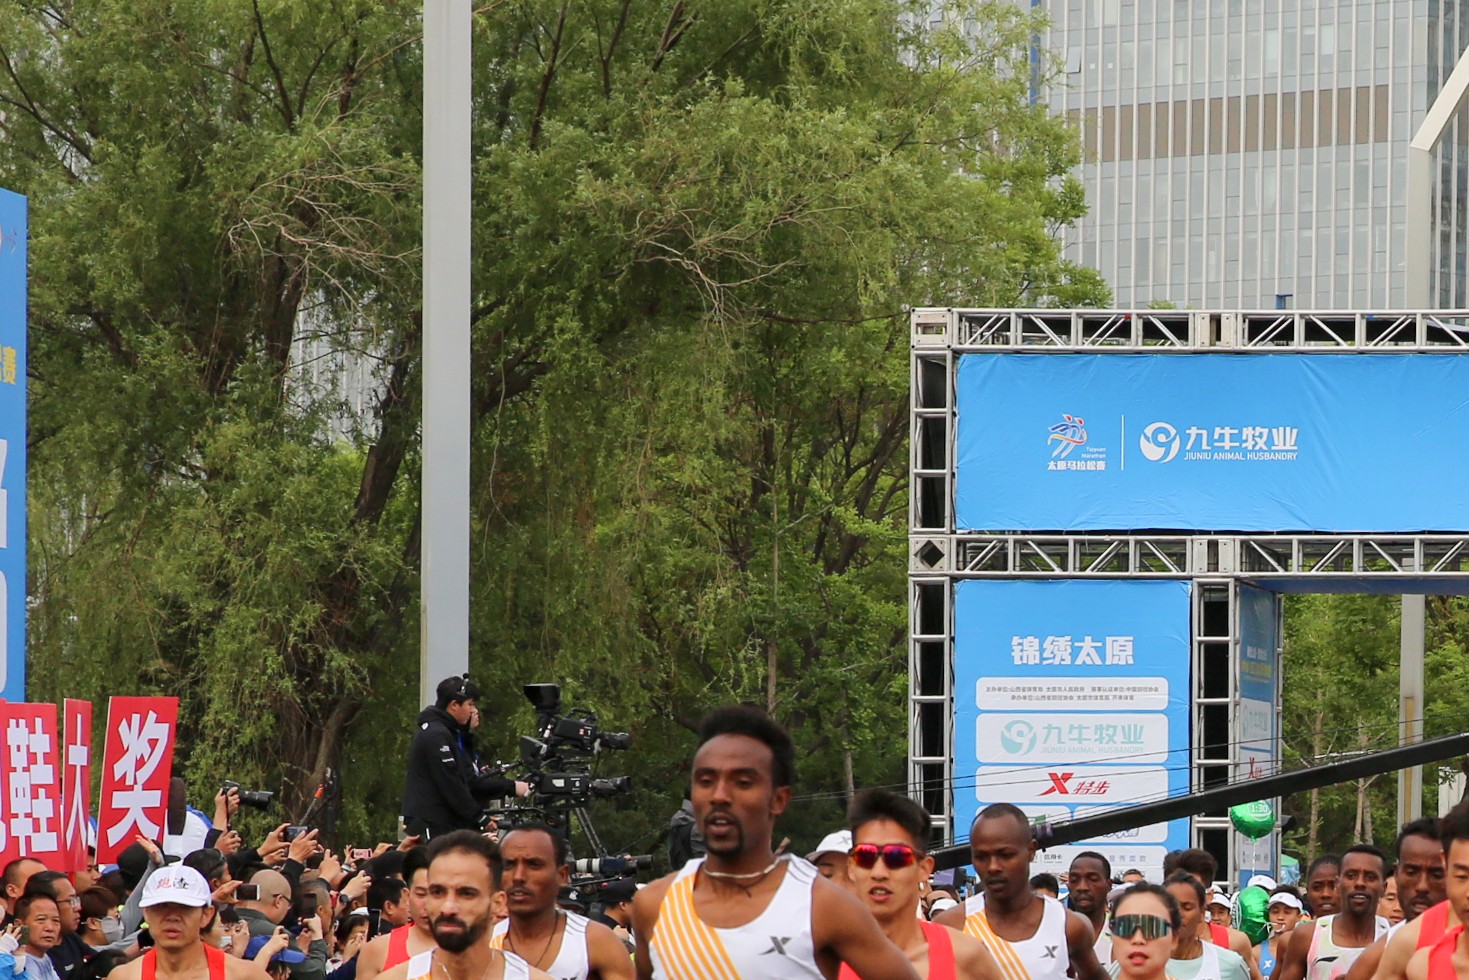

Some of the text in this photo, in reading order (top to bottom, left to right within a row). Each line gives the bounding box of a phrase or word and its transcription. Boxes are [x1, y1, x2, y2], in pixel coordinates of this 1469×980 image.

[1185, 426, 1298, 450] 九牛牧业
[1183, 451, 1298, 461] JIUNIU ANIMAL HUSBANDRY
[1011, 635, 1135, 666] 锦绣太原
[1042, 724, 1145, 745] 九牛牧业
[7, 717, 58, 857] 鞋
[66, 713, 88, 853] 大
[107, 709, 170, 848] 奖
[1073, 781, 1111, 795] 特步
